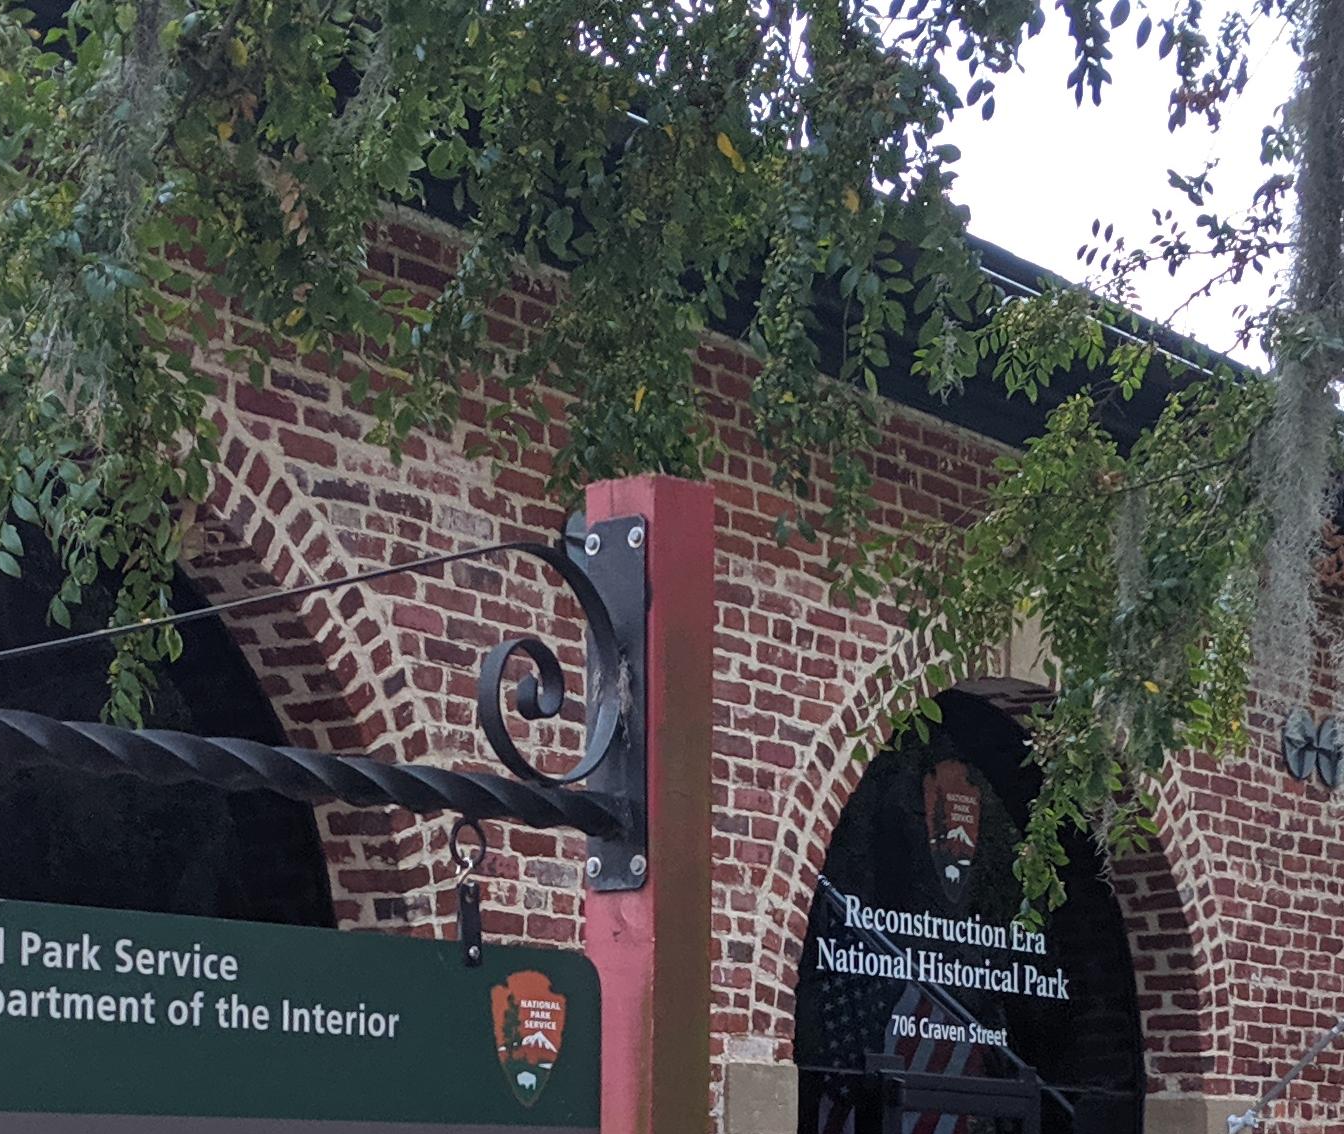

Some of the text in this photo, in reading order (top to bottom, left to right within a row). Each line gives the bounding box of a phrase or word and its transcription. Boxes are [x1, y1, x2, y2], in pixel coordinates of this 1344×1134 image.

[843, 893, 1048, 956] Reconstruction Era
[20, 930, 102, 973] Park
[114, 937, 239, 982] Service
[815, 936, 1071, 1001] National Historical Park
[166, 997, 206, 1028] of
[214, 996, 271, 1033] the
[281, 998, 401, 1039] Interior
[520, 999, 561, 1011] NATIONAL
[530, 1010, 552, 1020] PARK
[524, 1019, 557, 1031] SERVICE
[891, 1014, 1009, 1048] 706 Craven Street
